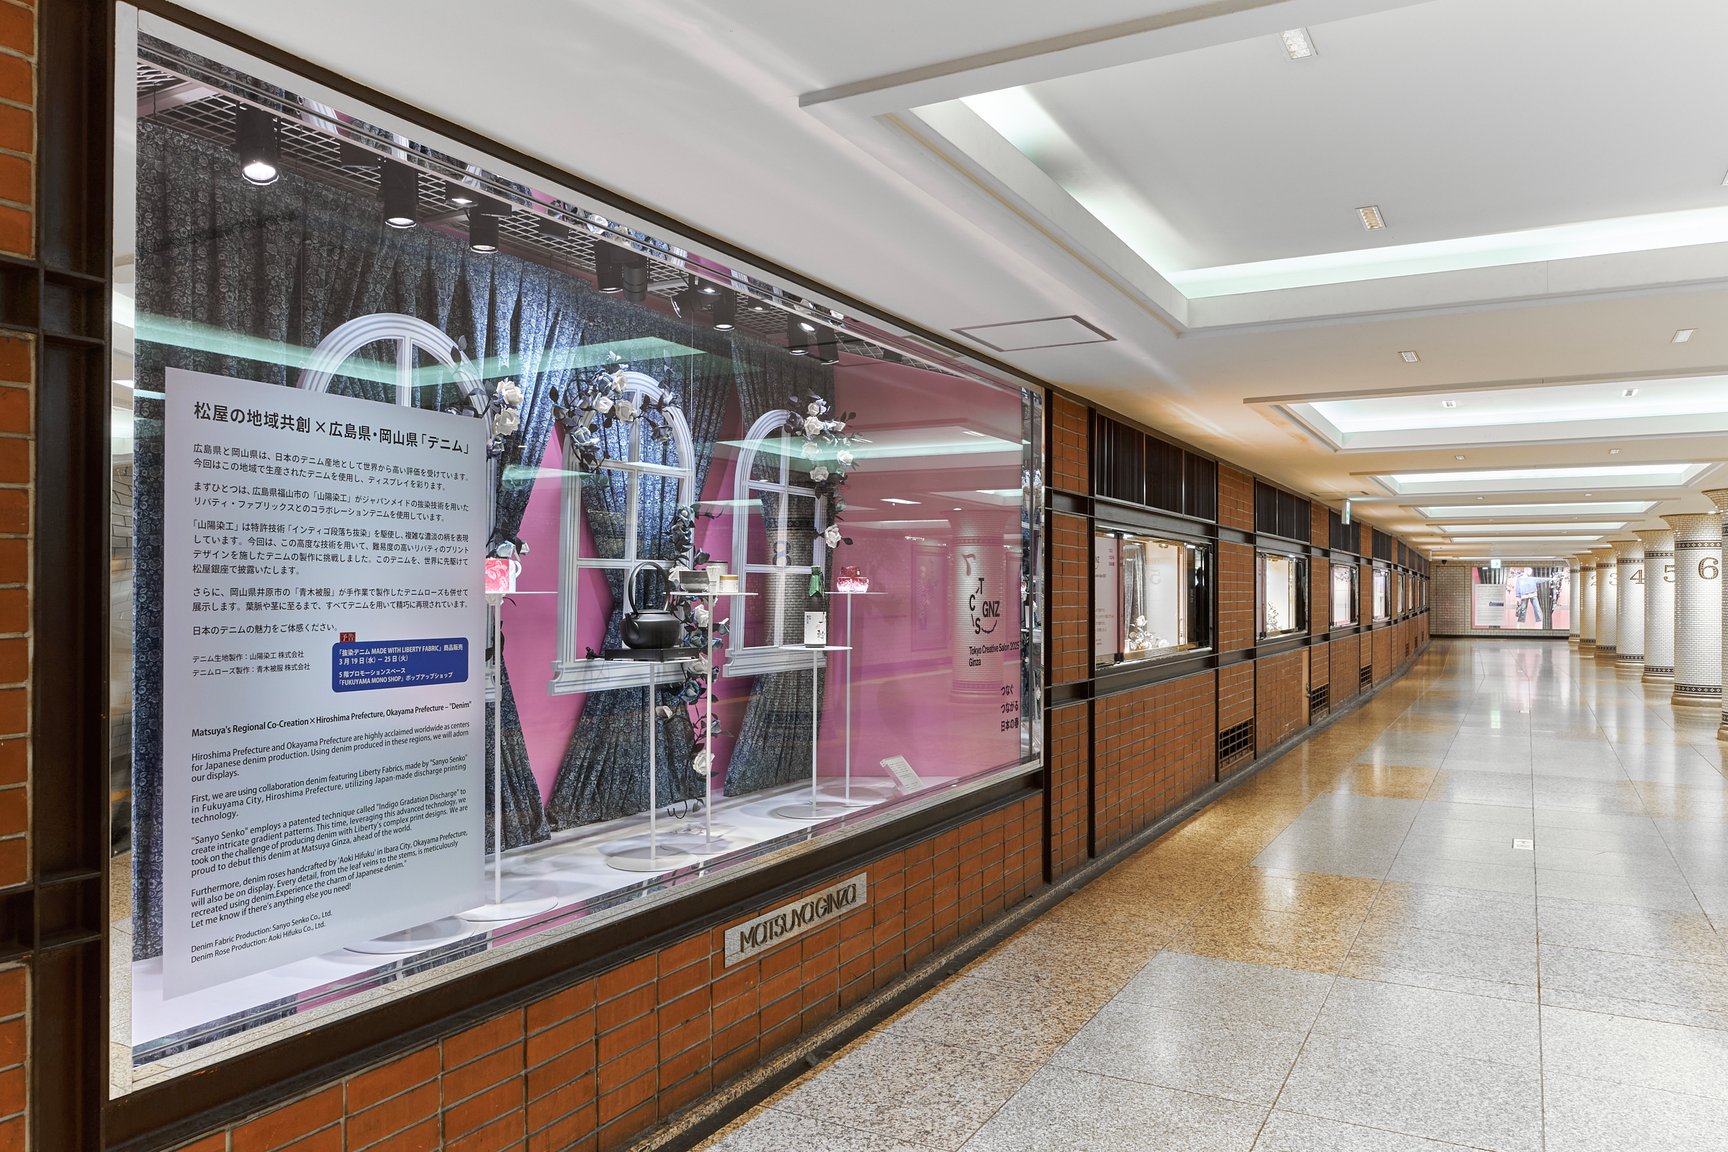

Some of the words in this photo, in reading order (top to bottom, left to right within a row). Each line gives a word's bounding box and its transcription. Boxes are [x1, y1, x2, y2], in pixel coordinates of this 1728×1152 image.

[194, 401, 310, 433] 松屋の地域共創
[328, 420, 469, 454] 広島県・岡山県「デニム」
[193, 443, 468, 481] 広島県と岡山県は、日本のデニム産地として世界から高い評価を受けています。
[193, 458, 445, 490] 今回はこの地域で生産されたデニムを使用し、ディスプレイを彩ります。
[192, 564, 299, 575] 松屋銀座で披露いたします。
[1630, 569, 1644, 584] 4
[1664, 565, 1675, 583] 5
[1698, 557, 1719, 580] 6
[982, 600, 1000, 618] GNZ
[192, 622, 338, 636] 日本のデニムの魅力をご体感ください。
[975, 617, 981, 635] S
[969, 646, 981, 656] Tokyo
[982, 644, 998, 653] Creative
[969, 658, 981, 667] Ginza
[232, 720, 265, 734] Regional
[266, 717, 308, 729] Co-Creation
[316, 713, 350, 724] Hiroshima
[385, 708, 413, 717] Okayama
[414, 704, 444, 713] Prefecture
[191, 749, 230, 761] Hiroshima
[232, 745, 270, 756] Prefecture
[271, 741, 285, 751] and
[286, 740, 318, 750] Okayama
[319, 735, 352, 745] Prefecture
[364, 730, 383, 741] highly
[384, 726, 413, 737] acclaimed
[414, 723, 443, 733] worldwide
[191, 762, 203, 772] for
[205, 759, 240, 771] Japanese
[242, 755, 266, 765] denim
[310, 747, 329, 756] Using
[331, 744, 352, 753] denim
[353, 738, 383, 752] produced
[391, 736, 408, 745] these
[442, 730, 452, 738] will
[452, 729, 468, 737] adorn
[191, 774, 205, 782] our
[212, 792, 223, 800] we
[224, 790, 236, 798] are
[237, 786, 257, 796] using
[258, 779, 304, 793] collaboration
[305, 775, 327, 785] denim
[328, 771, 357, 782] featuring
[358, 767, 380, 777] Liberty
[404, 760, 420, 770] made
[421, 759, 429, 768] by
[191, 844, 215, 856] create
[217, 838, 249, 850] intricate
[250, 831, 281, 846] gradient
[316, 821, 330, 831] This
[349, 812, 382, 824] leveraging
[384, 809, 395, 818] this
[396, 802, 424, 815] advanced
[249, 822, 281, 834] employs
[288, 813, 320, 829] patented
[322, 808, 355, 820] technique
[356, 803, 375, 814] called
[399, 795, 428, 806] Gradation
[191, 901, 227, 918] recreated
[229, 898, 249, 909] using
[314, 878, 325, 888] the
[326, 875, 346, 885] charm
[347, 871, 354, 880] of
[355, 866, 383, 879] Japanese
[191, 918, 203, 929] Let
[205, 916, 217, 925] me
[219, 910, 240, 922] know
[241, 906, 247, 916] if
[273, 894, 304, 908] anything
[305, 890, 318, 900] else
[319, 888, 332, 898] you
[333, 881, 351, 893] need!
[191, 942, 213, 953] Denim
[214, 935, 234, 946] Fabric
[235, 925, 271, 941] Production:
[272, 921, 290, 931] Sanyo
[291, 916, 309, 926] Senko
